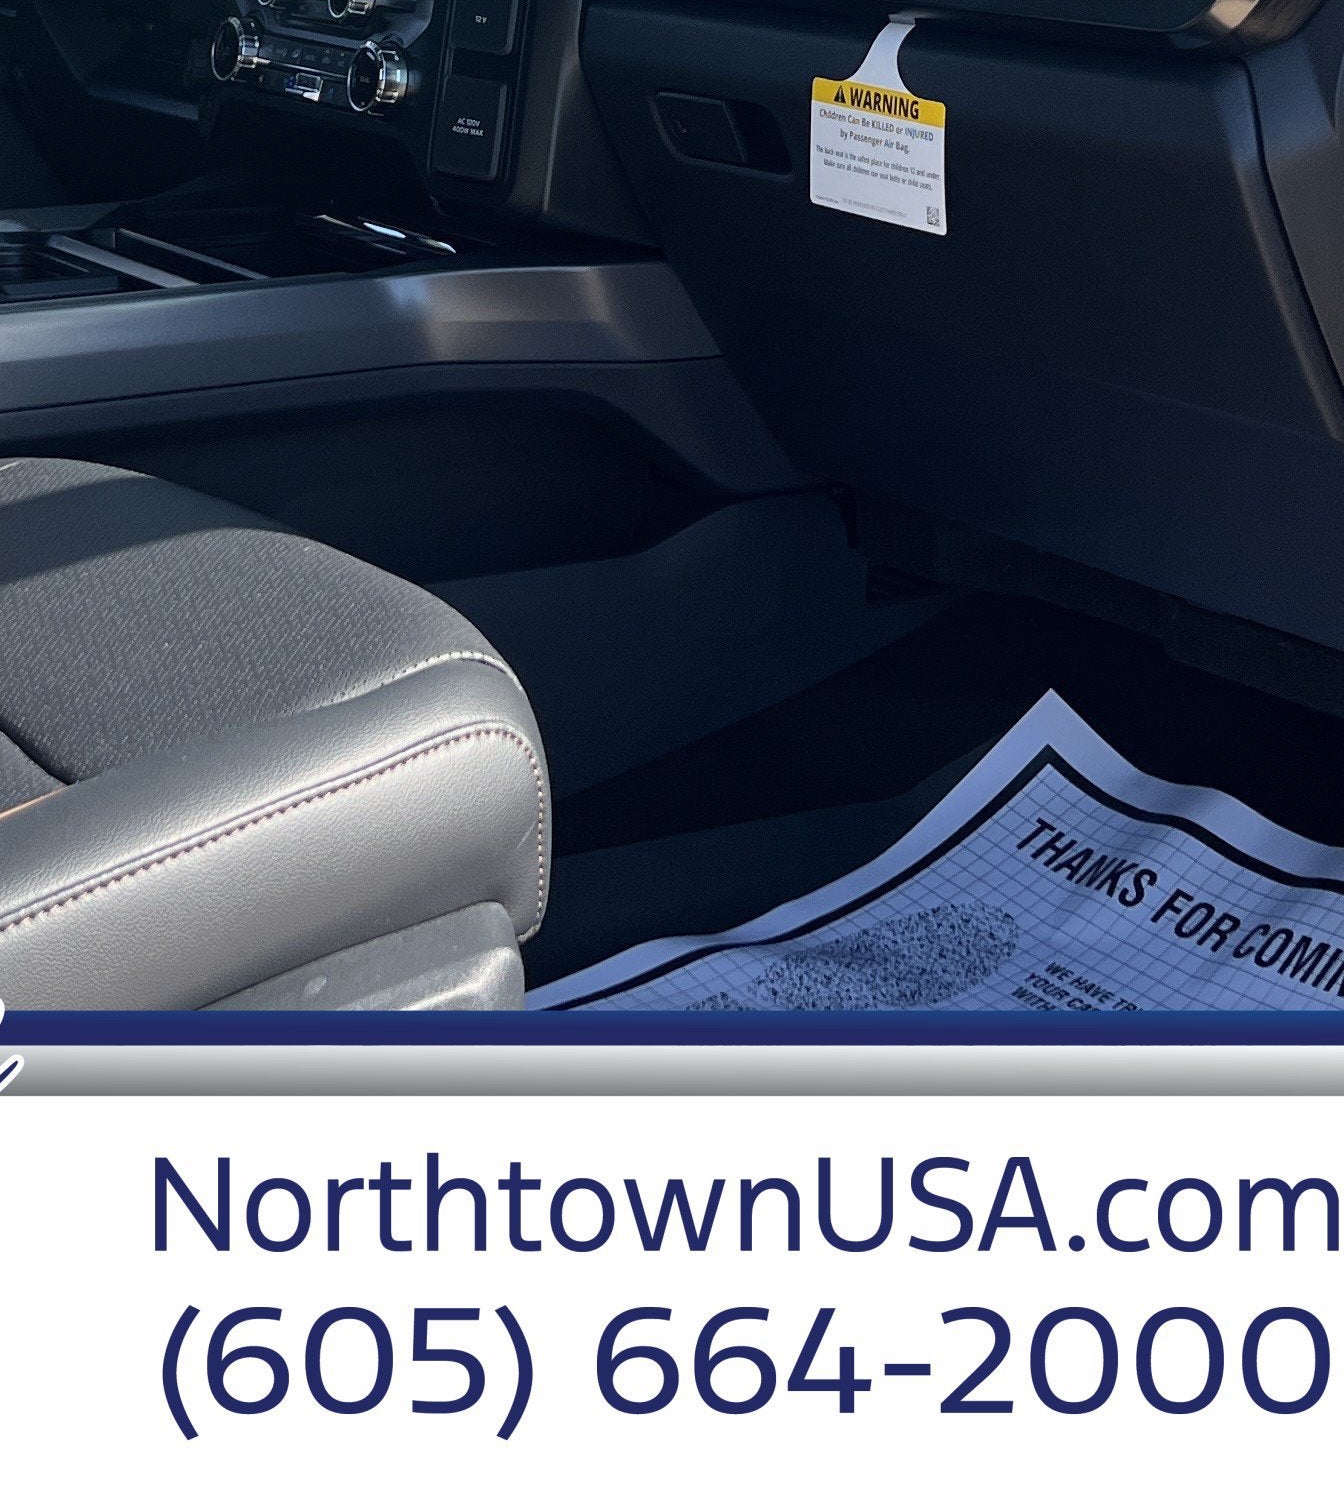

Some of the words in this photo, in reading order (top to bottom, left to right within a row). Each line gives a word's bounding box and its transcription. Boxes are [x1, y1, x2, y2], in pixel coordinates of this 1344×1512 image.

[850, 87, 919, 120] WARNING
[457, 117, 466, 125] AC
[819, 108, 847, 124] Children
[847, 114, 860, 125] Can
[861, 117, 871, 128] Be
[871, 120, 894, 133] KILLED
[904, 126, 934, 142] INJURED
[840, 128, 848, 141] by
[849, 130, 883, 148] Passenger
[883, 138, 894, 149] Air
[1014, 817, 1159, 909] THANKS
[1151, 888, 1241, 954] FOR
[1025, 972, 1071, 1001] YOUR
[1045, 961, 1074, 981] WE
[1069, 976, 1116, 1004] HAVE
[1011, 986, 1057, 1011] WITH
